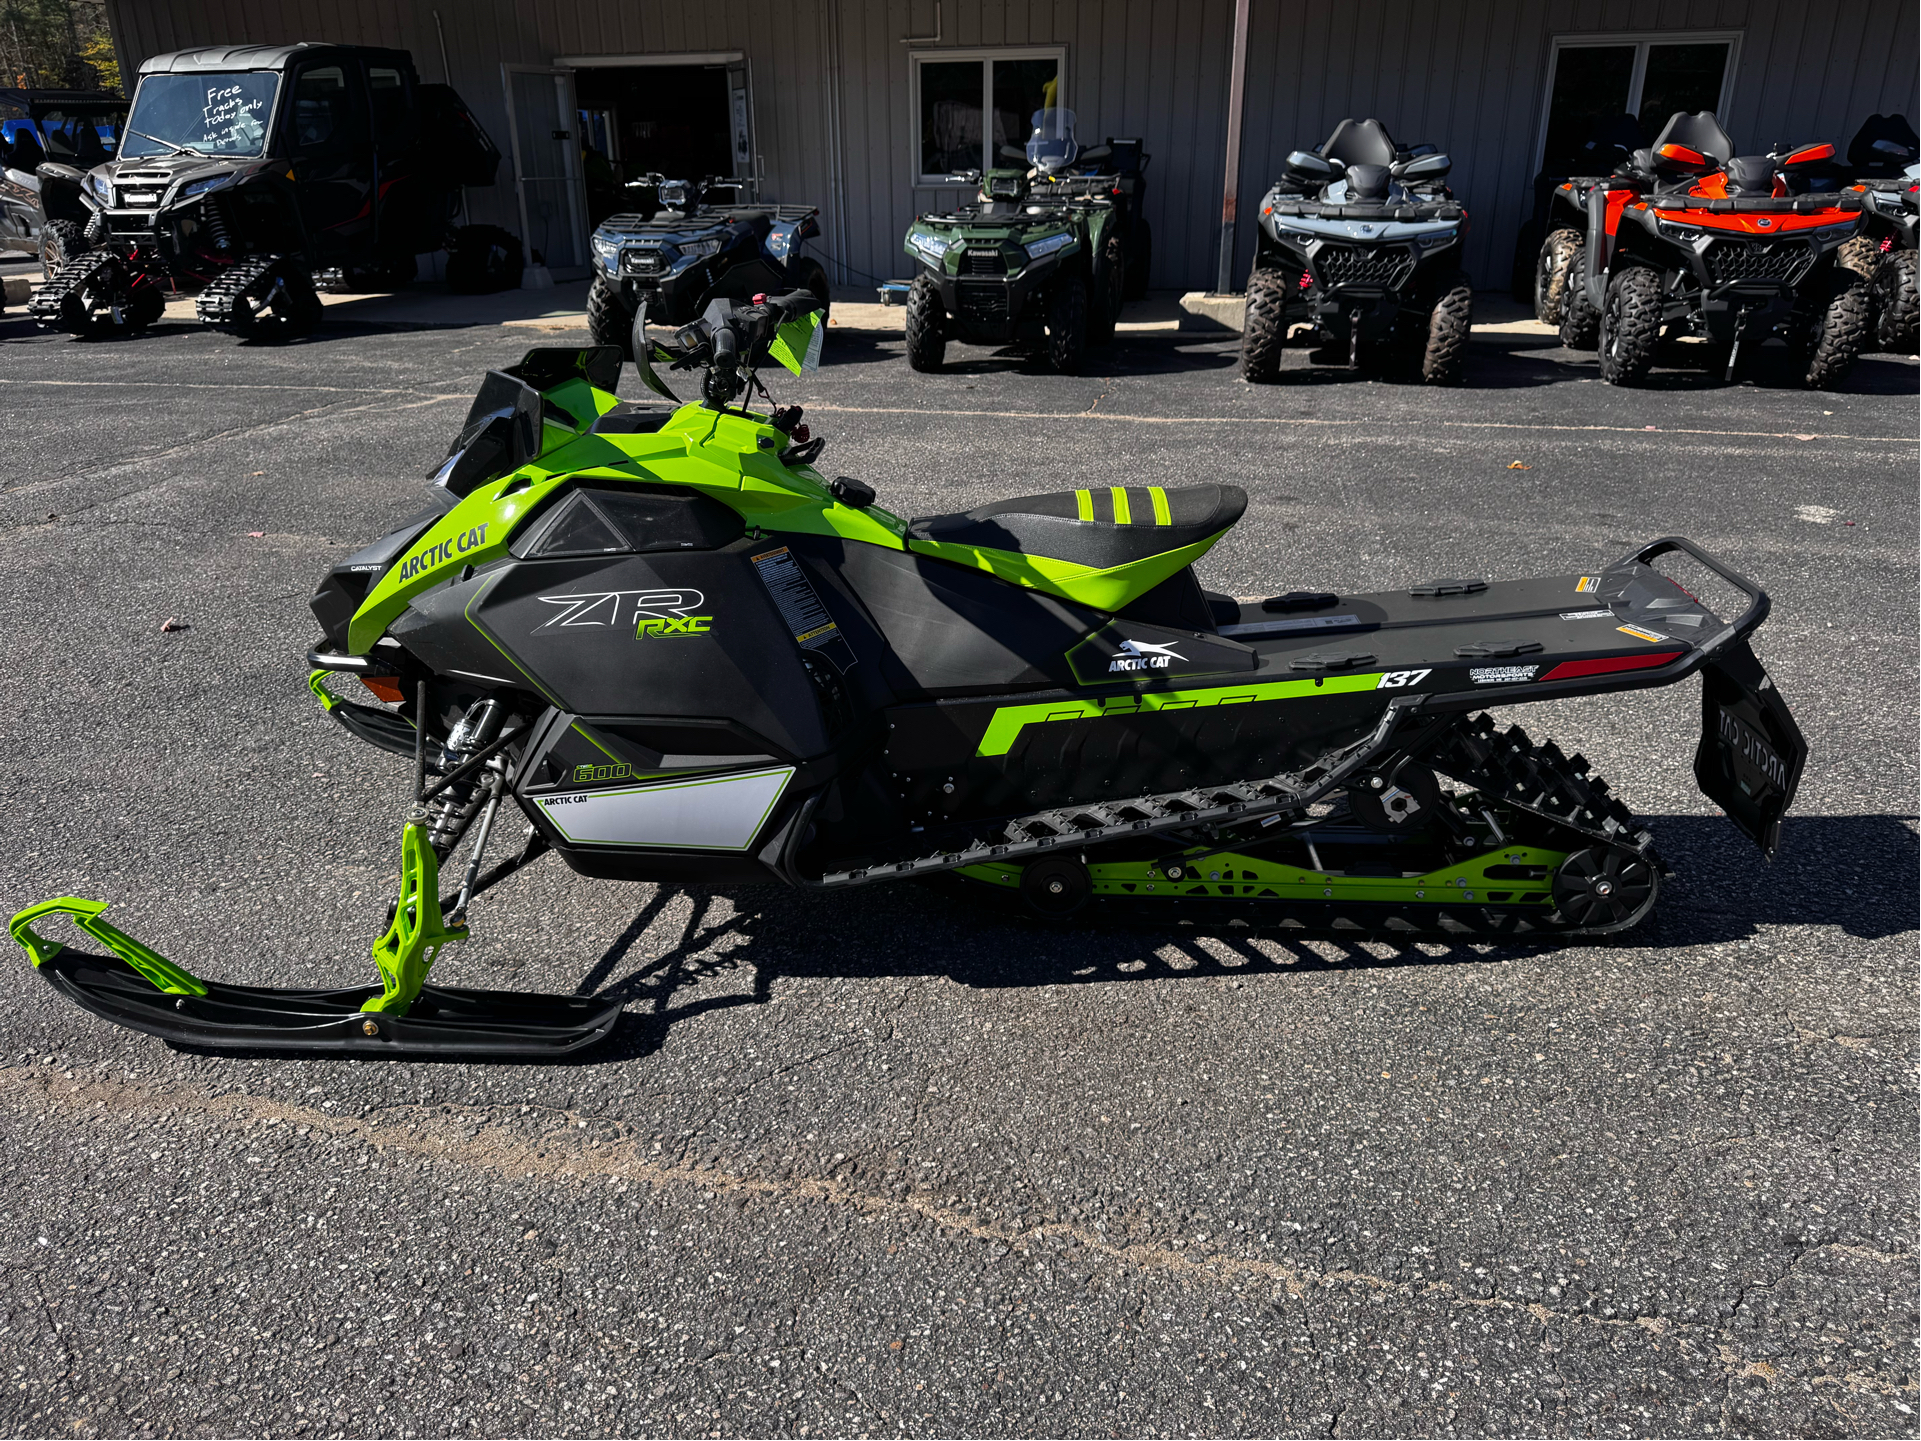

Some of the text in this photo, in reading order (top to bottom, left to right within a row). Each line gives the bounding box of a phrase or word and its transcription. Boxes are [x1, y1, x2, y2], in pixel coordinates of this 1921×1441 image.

[207, 85, 242, 106] Free
[203, 98, 242, 118] Tracks
[240, 99, 262, 114] only
[203, 132, 218, 142] Ask
[221, 121, 246, 135] inside
[967, 249, 999, 257] Kawasaki
[399, 522, 489, 584] ARCTIC CAT
[636, 616, 713, 640] RXC
[1108, 656, 1171, 672] ARCTIC CAT
[1469, 665, 1540, 676] NORTHEAST
[1376, 668, 1433, 689] 137
[573, 763, 631, 782] 600
[544, 795, 588, 806] ARCTIC CAT
